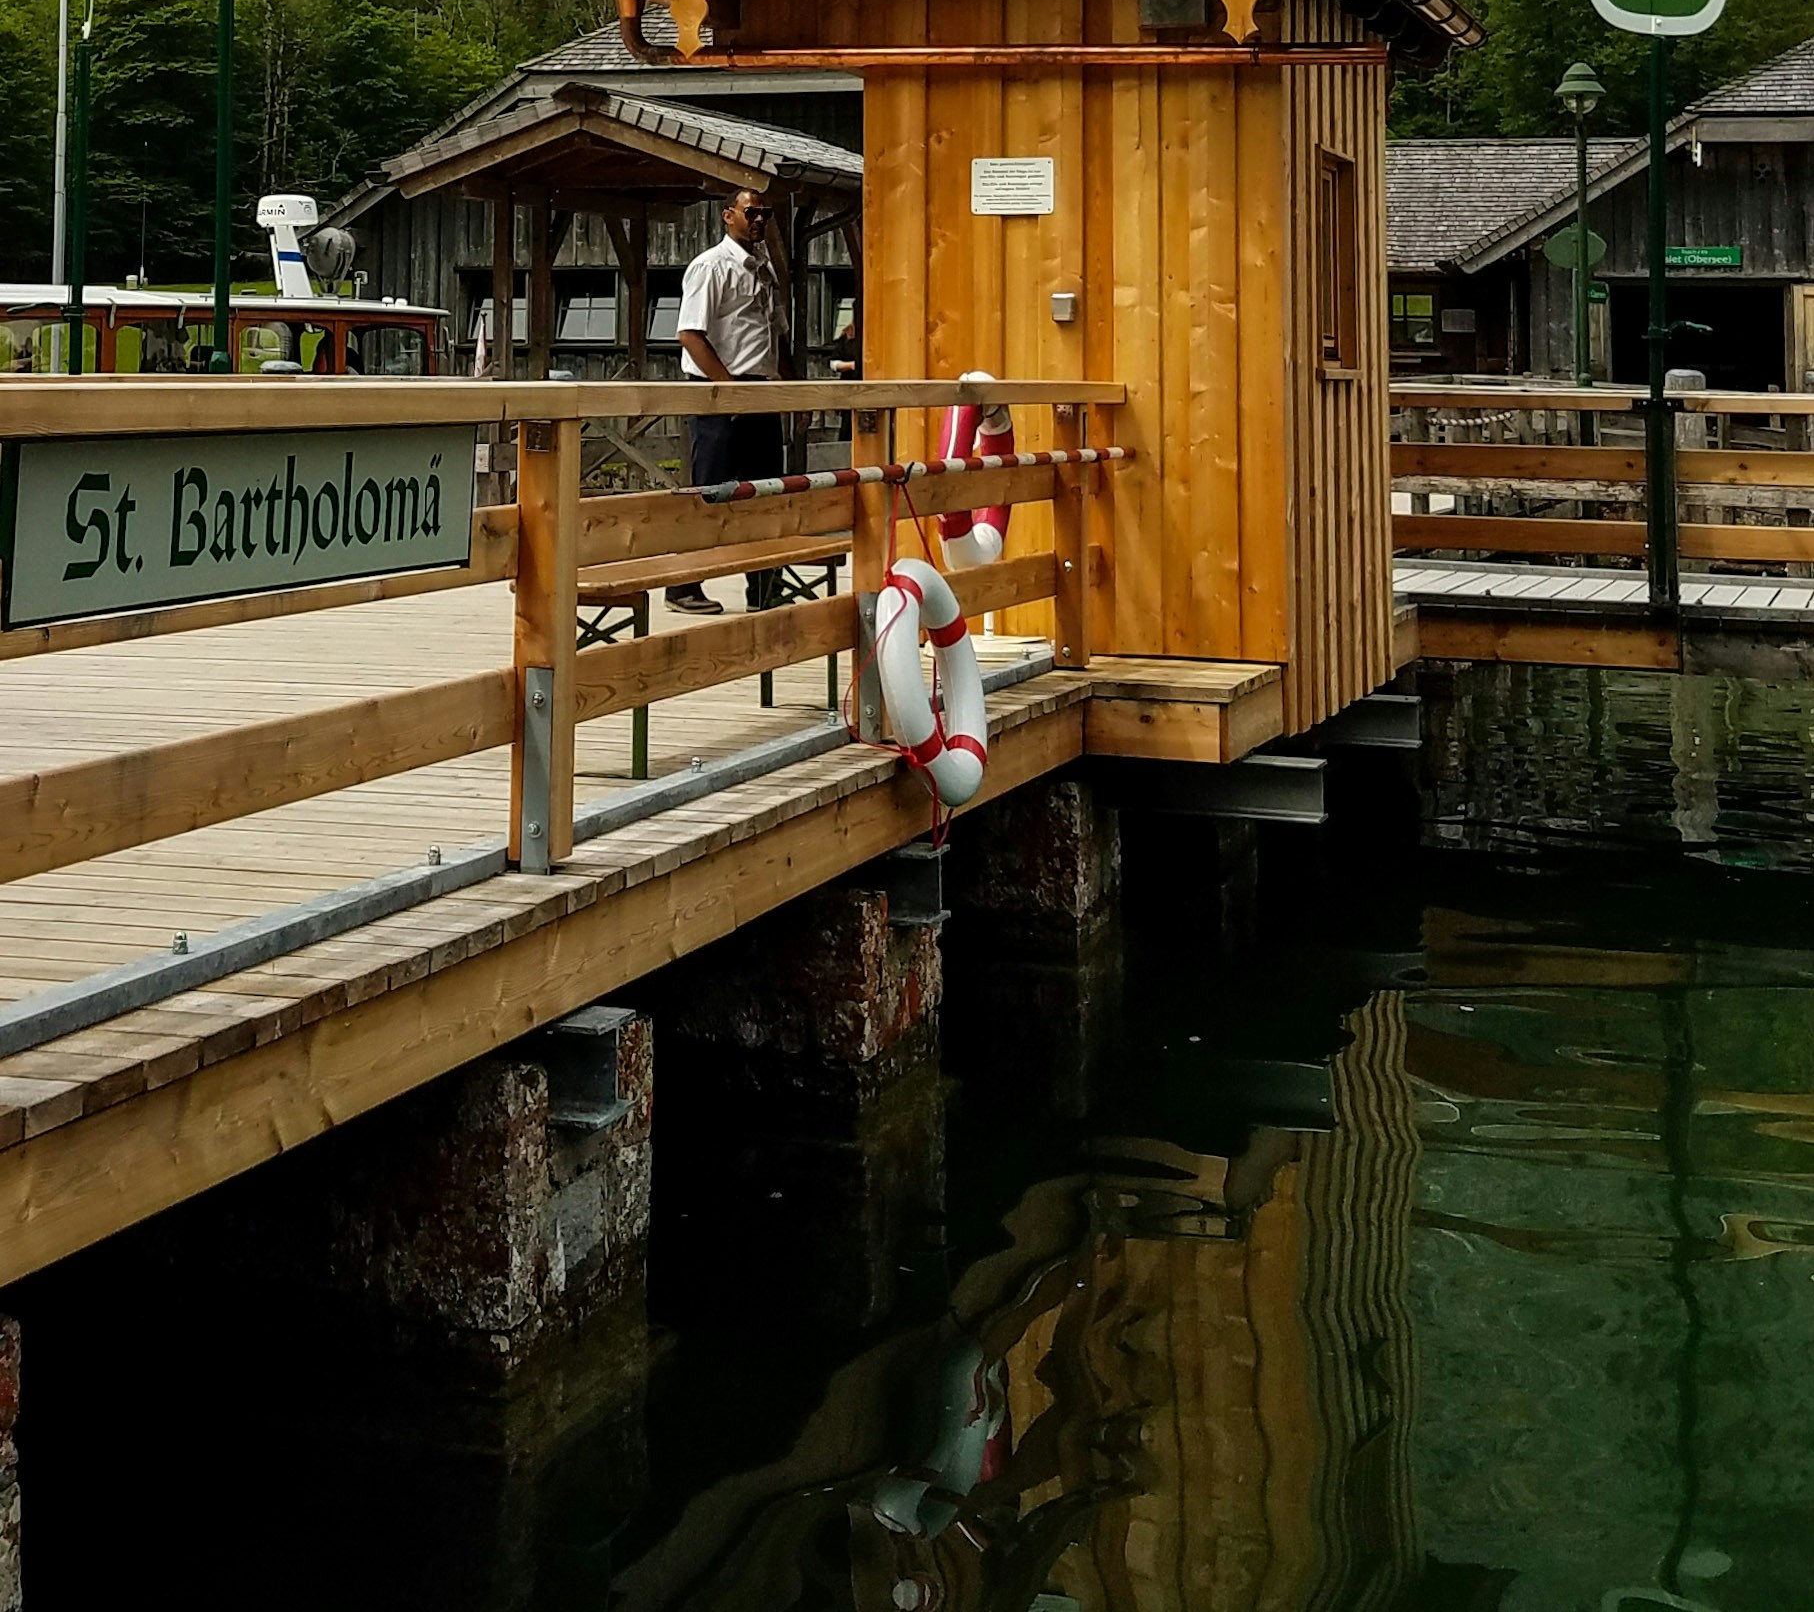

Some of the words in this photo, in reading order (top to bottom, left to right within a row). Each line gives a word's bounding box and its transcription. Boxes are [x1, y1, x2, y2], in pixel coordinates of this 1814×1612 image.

[1665, 254, 1682, 264] alet
[1684, 255, 1732, 264] (Obersee)
[62, 472, 144, 582] St.
[169, 451, 443, 568] Bartholomä
